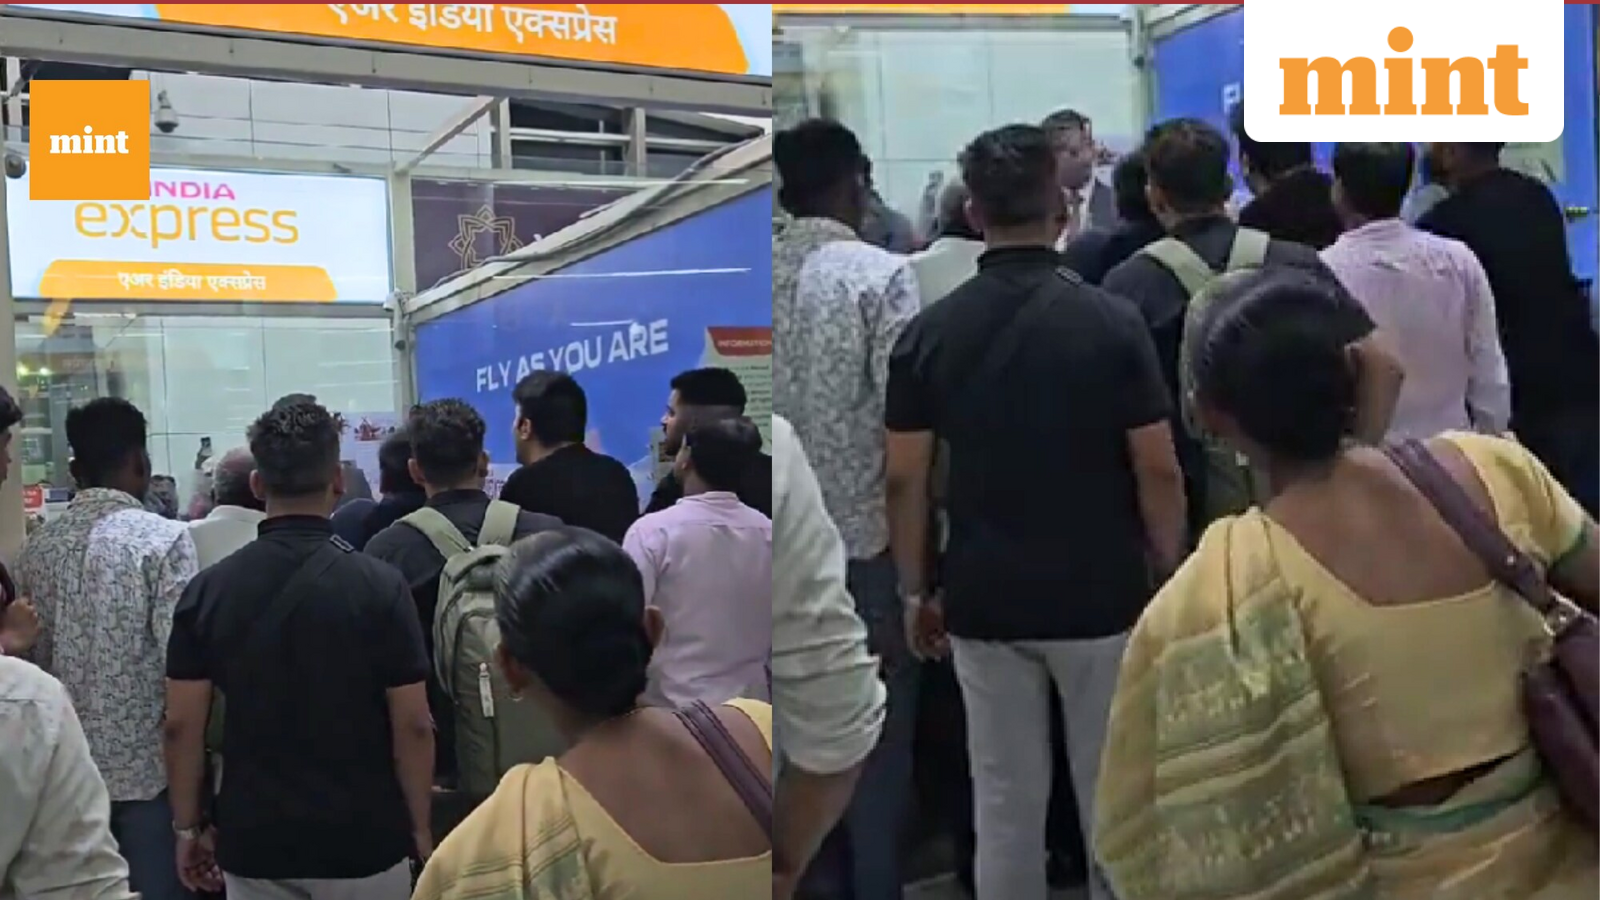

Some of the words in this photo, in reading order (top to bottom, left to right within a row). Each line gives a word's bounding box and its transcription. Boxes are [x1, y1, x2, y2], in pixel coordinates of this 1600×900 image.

[74, 201, 299, 249] express
[476, 360, 512, 393] FLY
[548, 335, 603, 374] YOU
[607, 318, 670, 363] ARE
